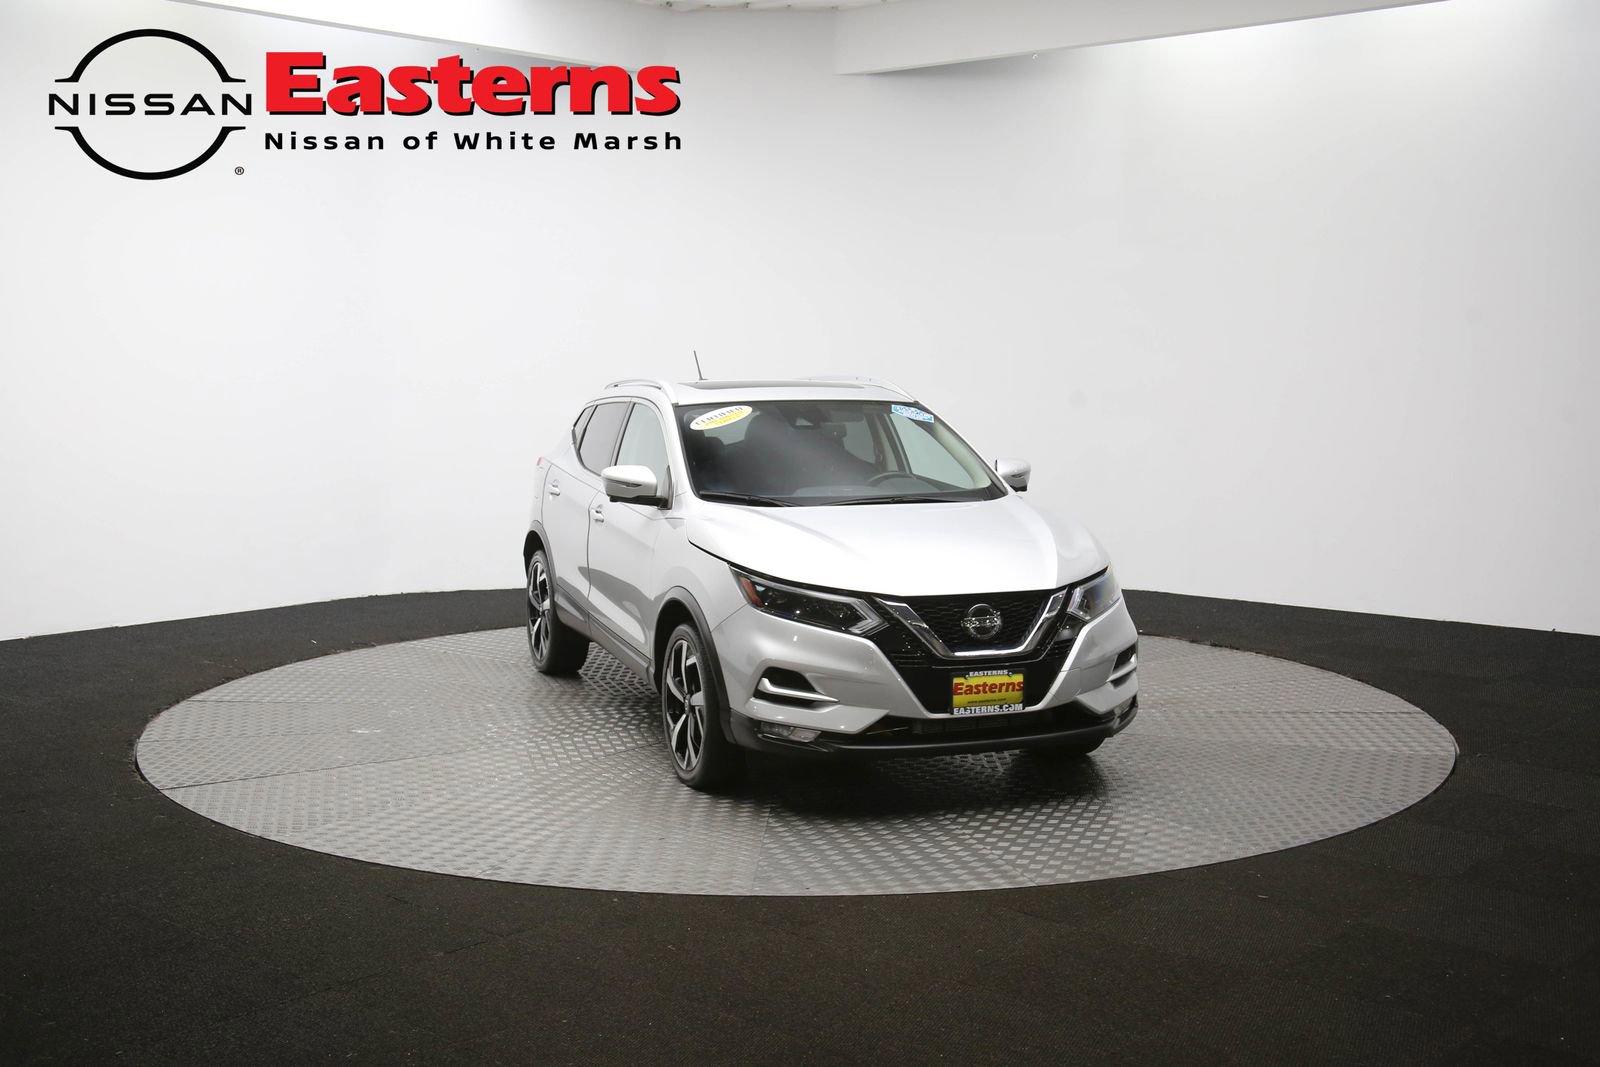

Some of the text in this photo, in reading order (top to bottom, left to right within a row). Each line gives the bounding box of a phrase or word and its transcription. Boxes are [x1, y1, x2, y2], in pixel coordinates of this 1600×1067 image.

[969, 669, 1009, 677] EASTERNS
[953, 681, 1024, 696] Easterns
[953, 703, 1023, 715] EASTERNS.COM
